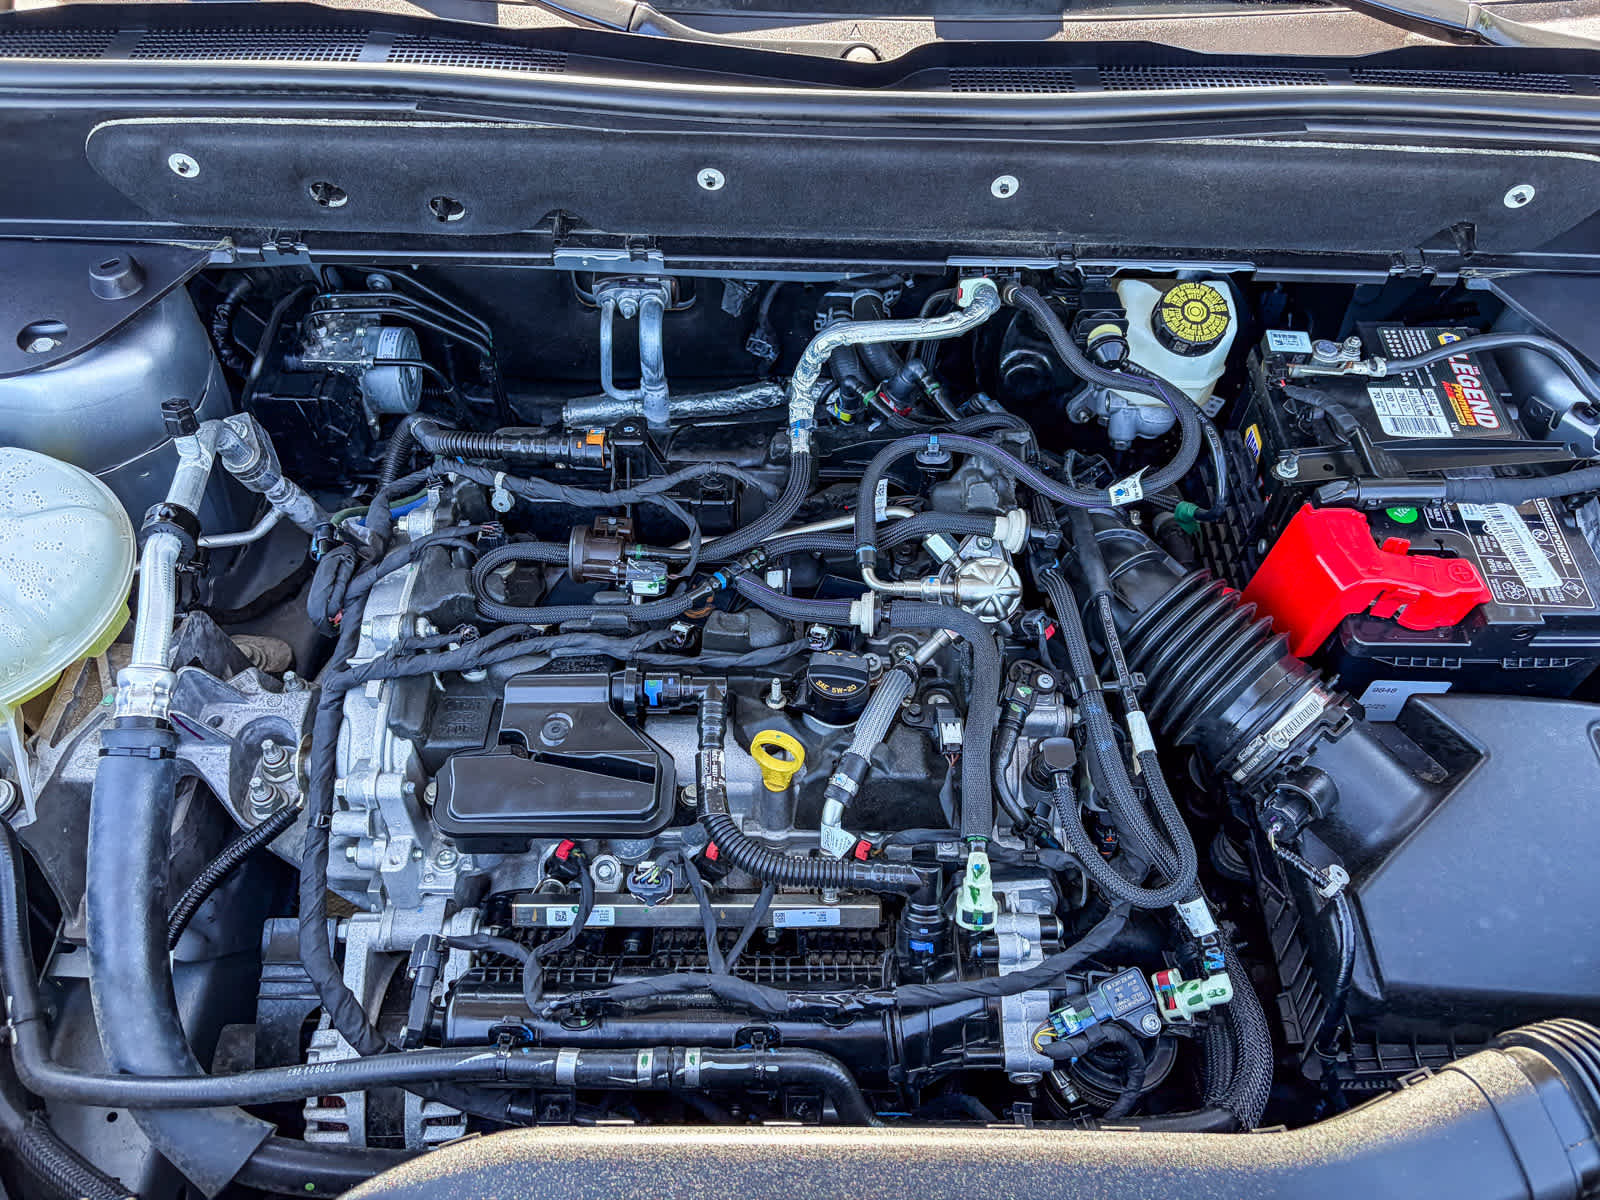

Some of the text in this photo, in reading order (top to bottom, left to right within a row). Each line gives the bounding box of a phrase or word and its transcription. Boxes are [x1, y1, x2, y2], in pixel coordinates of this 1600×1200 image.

[1448, 354, 1500, 428] LEGEND
[1451, 384, 1476, 425] Premium
[816, 680, 829, 691] SAE
